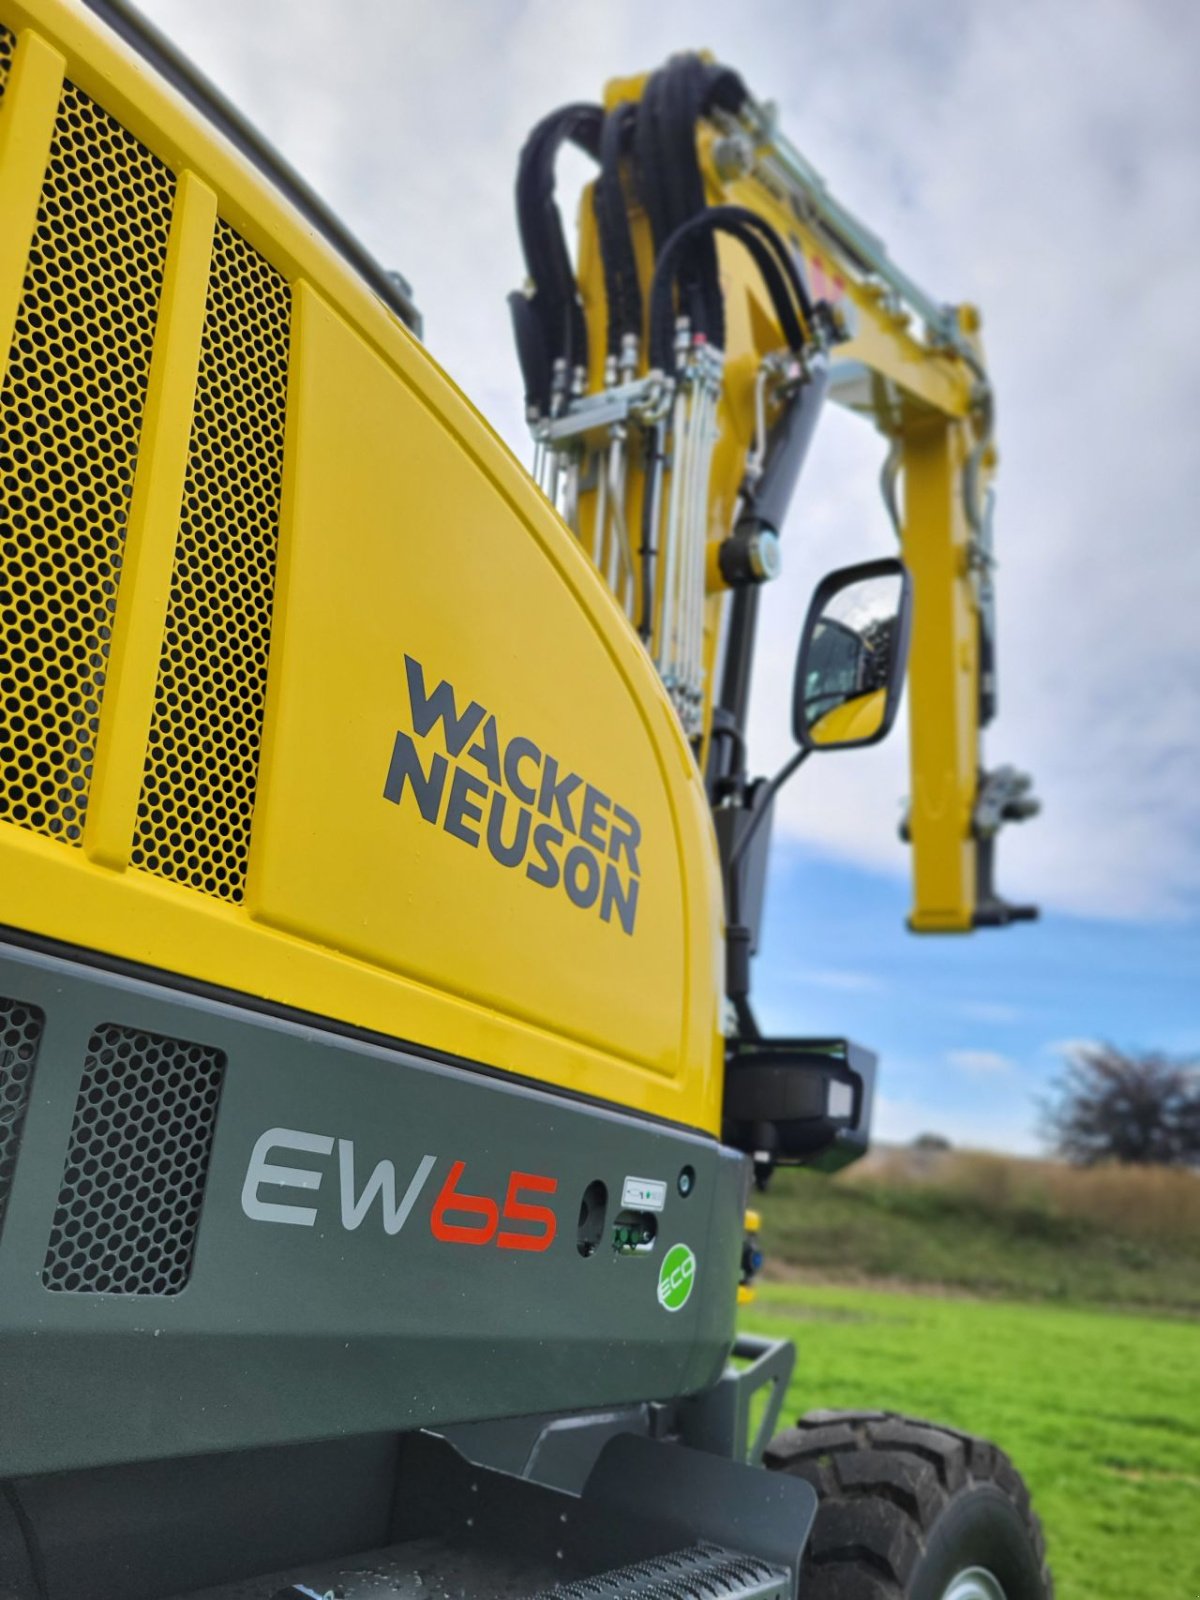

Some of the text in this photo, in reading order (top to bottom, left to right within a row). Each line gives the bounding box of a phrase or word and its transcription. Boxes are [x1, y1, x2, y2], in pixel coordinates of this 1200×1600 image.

[383, 730, 640, 937] NEUSON
[404, 653, 641, 877] WACKER
[241, 1127, 558, 1251] EW65
[657, 1254, 696, 1303] ECO
